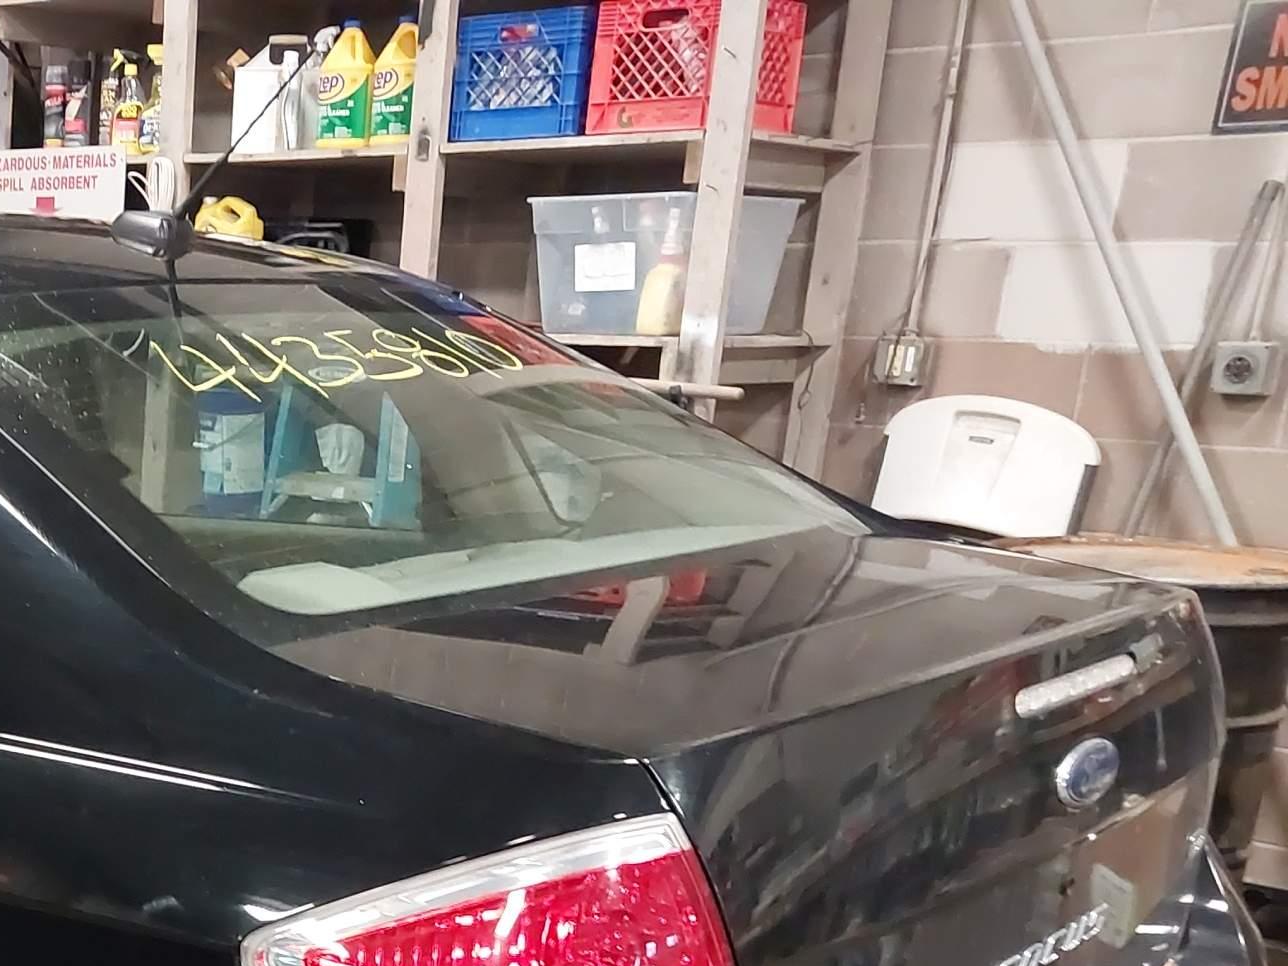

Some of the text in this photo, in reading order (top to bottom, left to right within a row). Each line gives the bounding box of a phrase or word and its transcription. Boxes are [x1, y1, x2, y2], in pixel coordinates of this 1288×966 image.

[376, 71, 393, 89] ep
[1231, 66, 1288, 112] SM
[52, 153, 117, 170] MATERIALS
[30, 175, 98, 191] ABSORBENT
